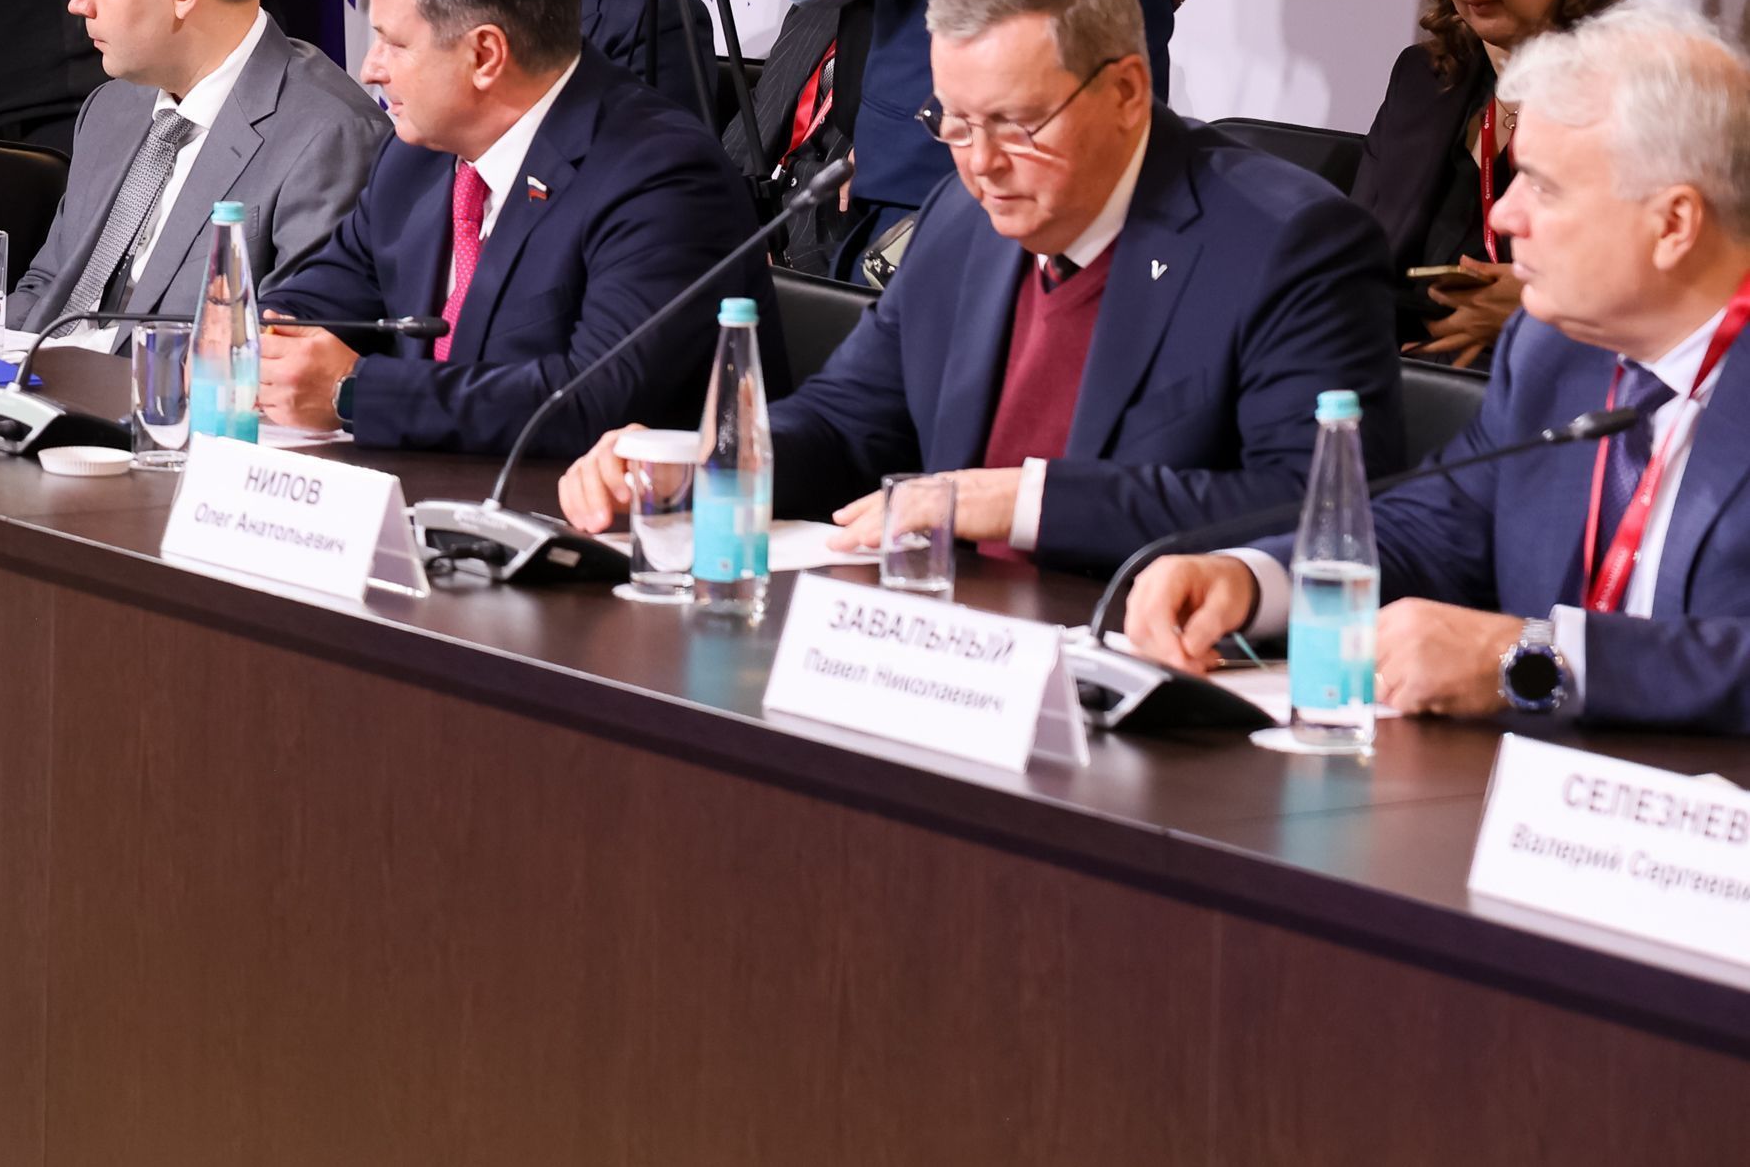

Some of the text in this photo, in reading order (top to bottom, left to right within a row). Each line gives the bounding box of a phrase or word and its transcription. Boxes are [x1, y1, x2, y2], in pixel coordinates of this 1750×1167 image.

[244, 465, 323, 506] НИЛОВ
[194, 502, 346, 555] Олег Анатольевич
[828, 599, 1017, 667] ЗАВАЛЬНЫЙ
[803, 646, 1005, 715] Павел Николаевич
[1562, 772, 1749, 845] СЕЛЕЗНЕВ
[1510, 822, 1625, 871] Валерий
